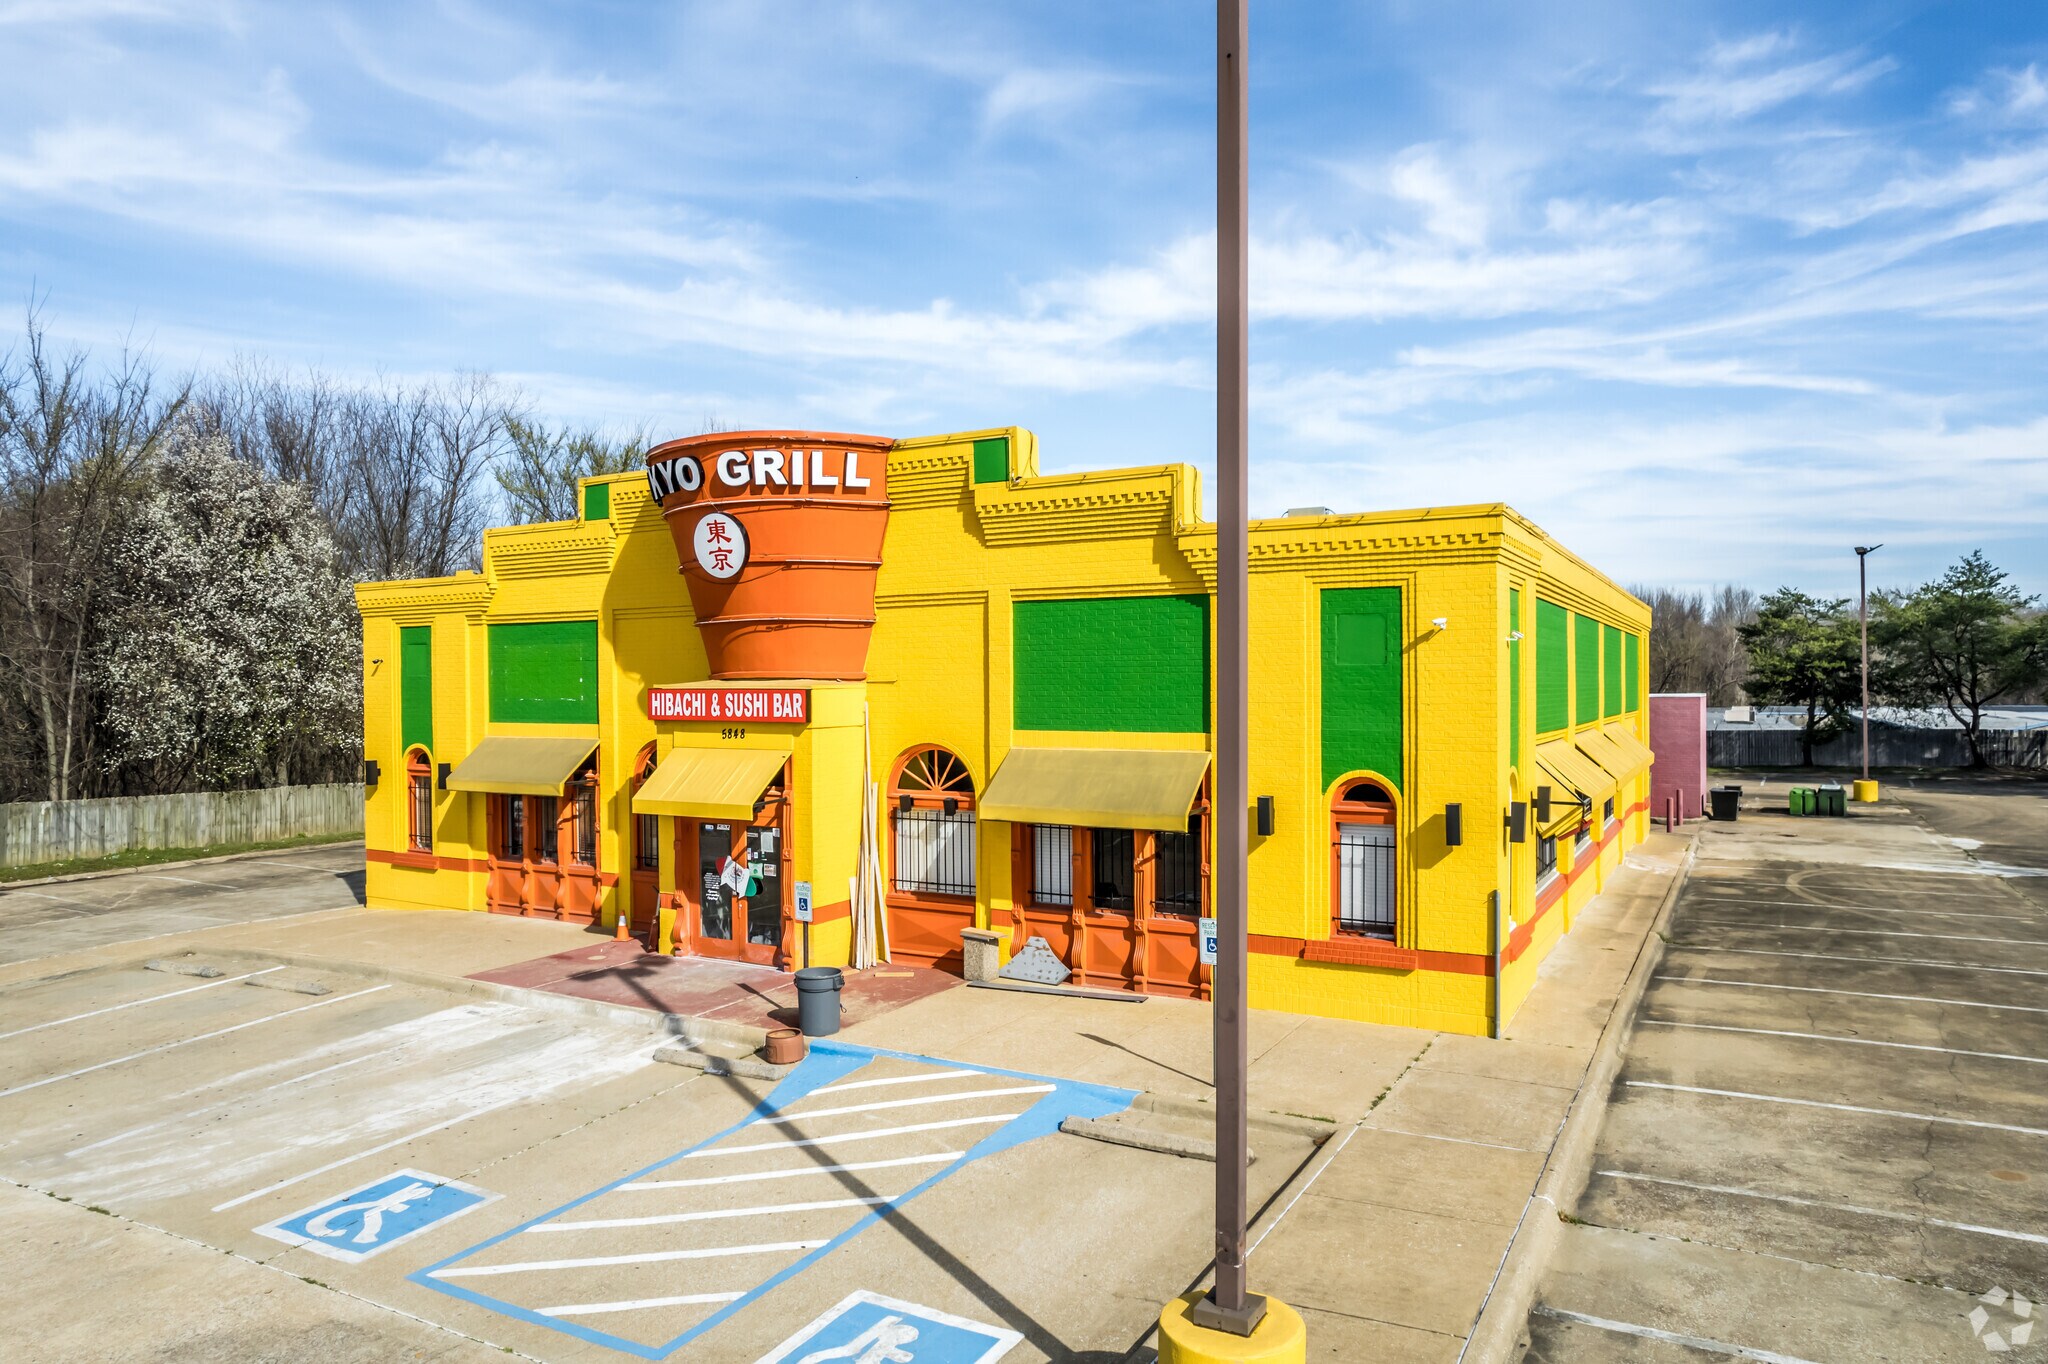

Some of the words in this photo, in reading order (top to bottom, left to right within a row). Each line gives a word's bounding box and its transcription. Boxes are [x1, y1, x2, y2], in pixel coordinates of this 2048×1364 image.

[716, 450, 871, 488] GRILL
[706, 519, 734, 571] 東京
[651, 692, 706, 717] HIBACHI
[710, 693, 721, 718] &
[725, 693, 768, 718] SUSHI
[773, 693, 803, 718] BAR
[721, 728, 745, 740] 5848
